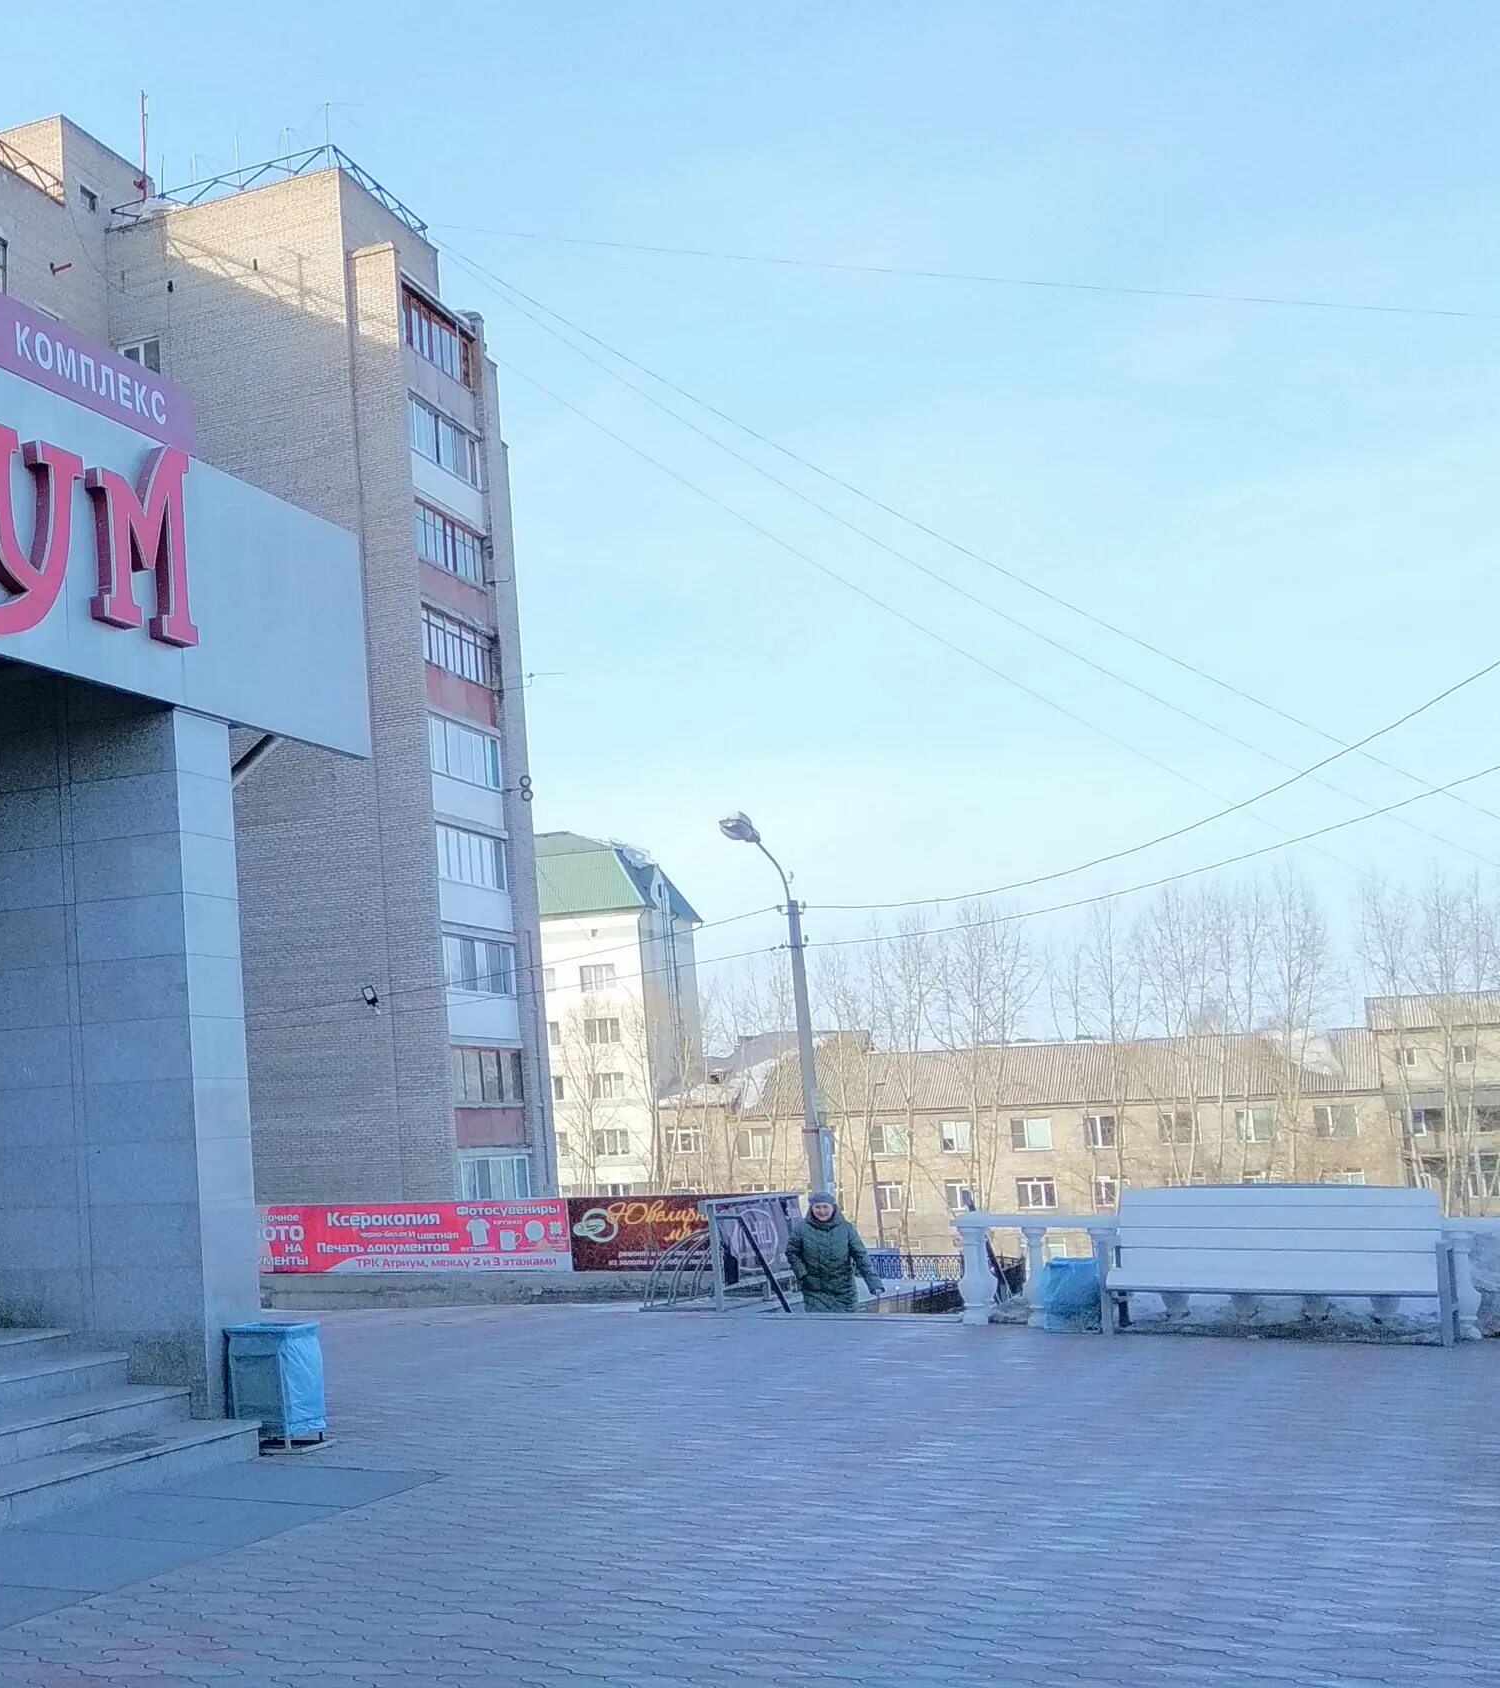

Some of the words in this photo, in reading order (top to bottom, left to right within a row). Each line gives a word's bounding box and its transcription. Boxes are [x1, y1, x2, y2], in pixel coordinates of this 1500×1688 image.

[15, 326, 168, 426] КОМПЛЕКС
[456, 1205, 560, 1217] Фотосувениры
[327, 1212, 440, 1229] Ксерокопия
[259, 1225, 304, 1241] ОТО
[417, 1232, 458, 1240] цветная
[285, 1244, 302, 1253] НА
[317, 1242, 364, 1253] Печать
[367, 1243, 450, 1255] документов
[356, 1258, 379, 1267] ТРК
[382, 1258, 428, 1269] Атриум,
[431, 1258, 470, 1268] между
[473, 1257, 481, 1266] 2
[493, 1257, 500, 1266] 3
[502, 1258, 556, 1267] этажами
